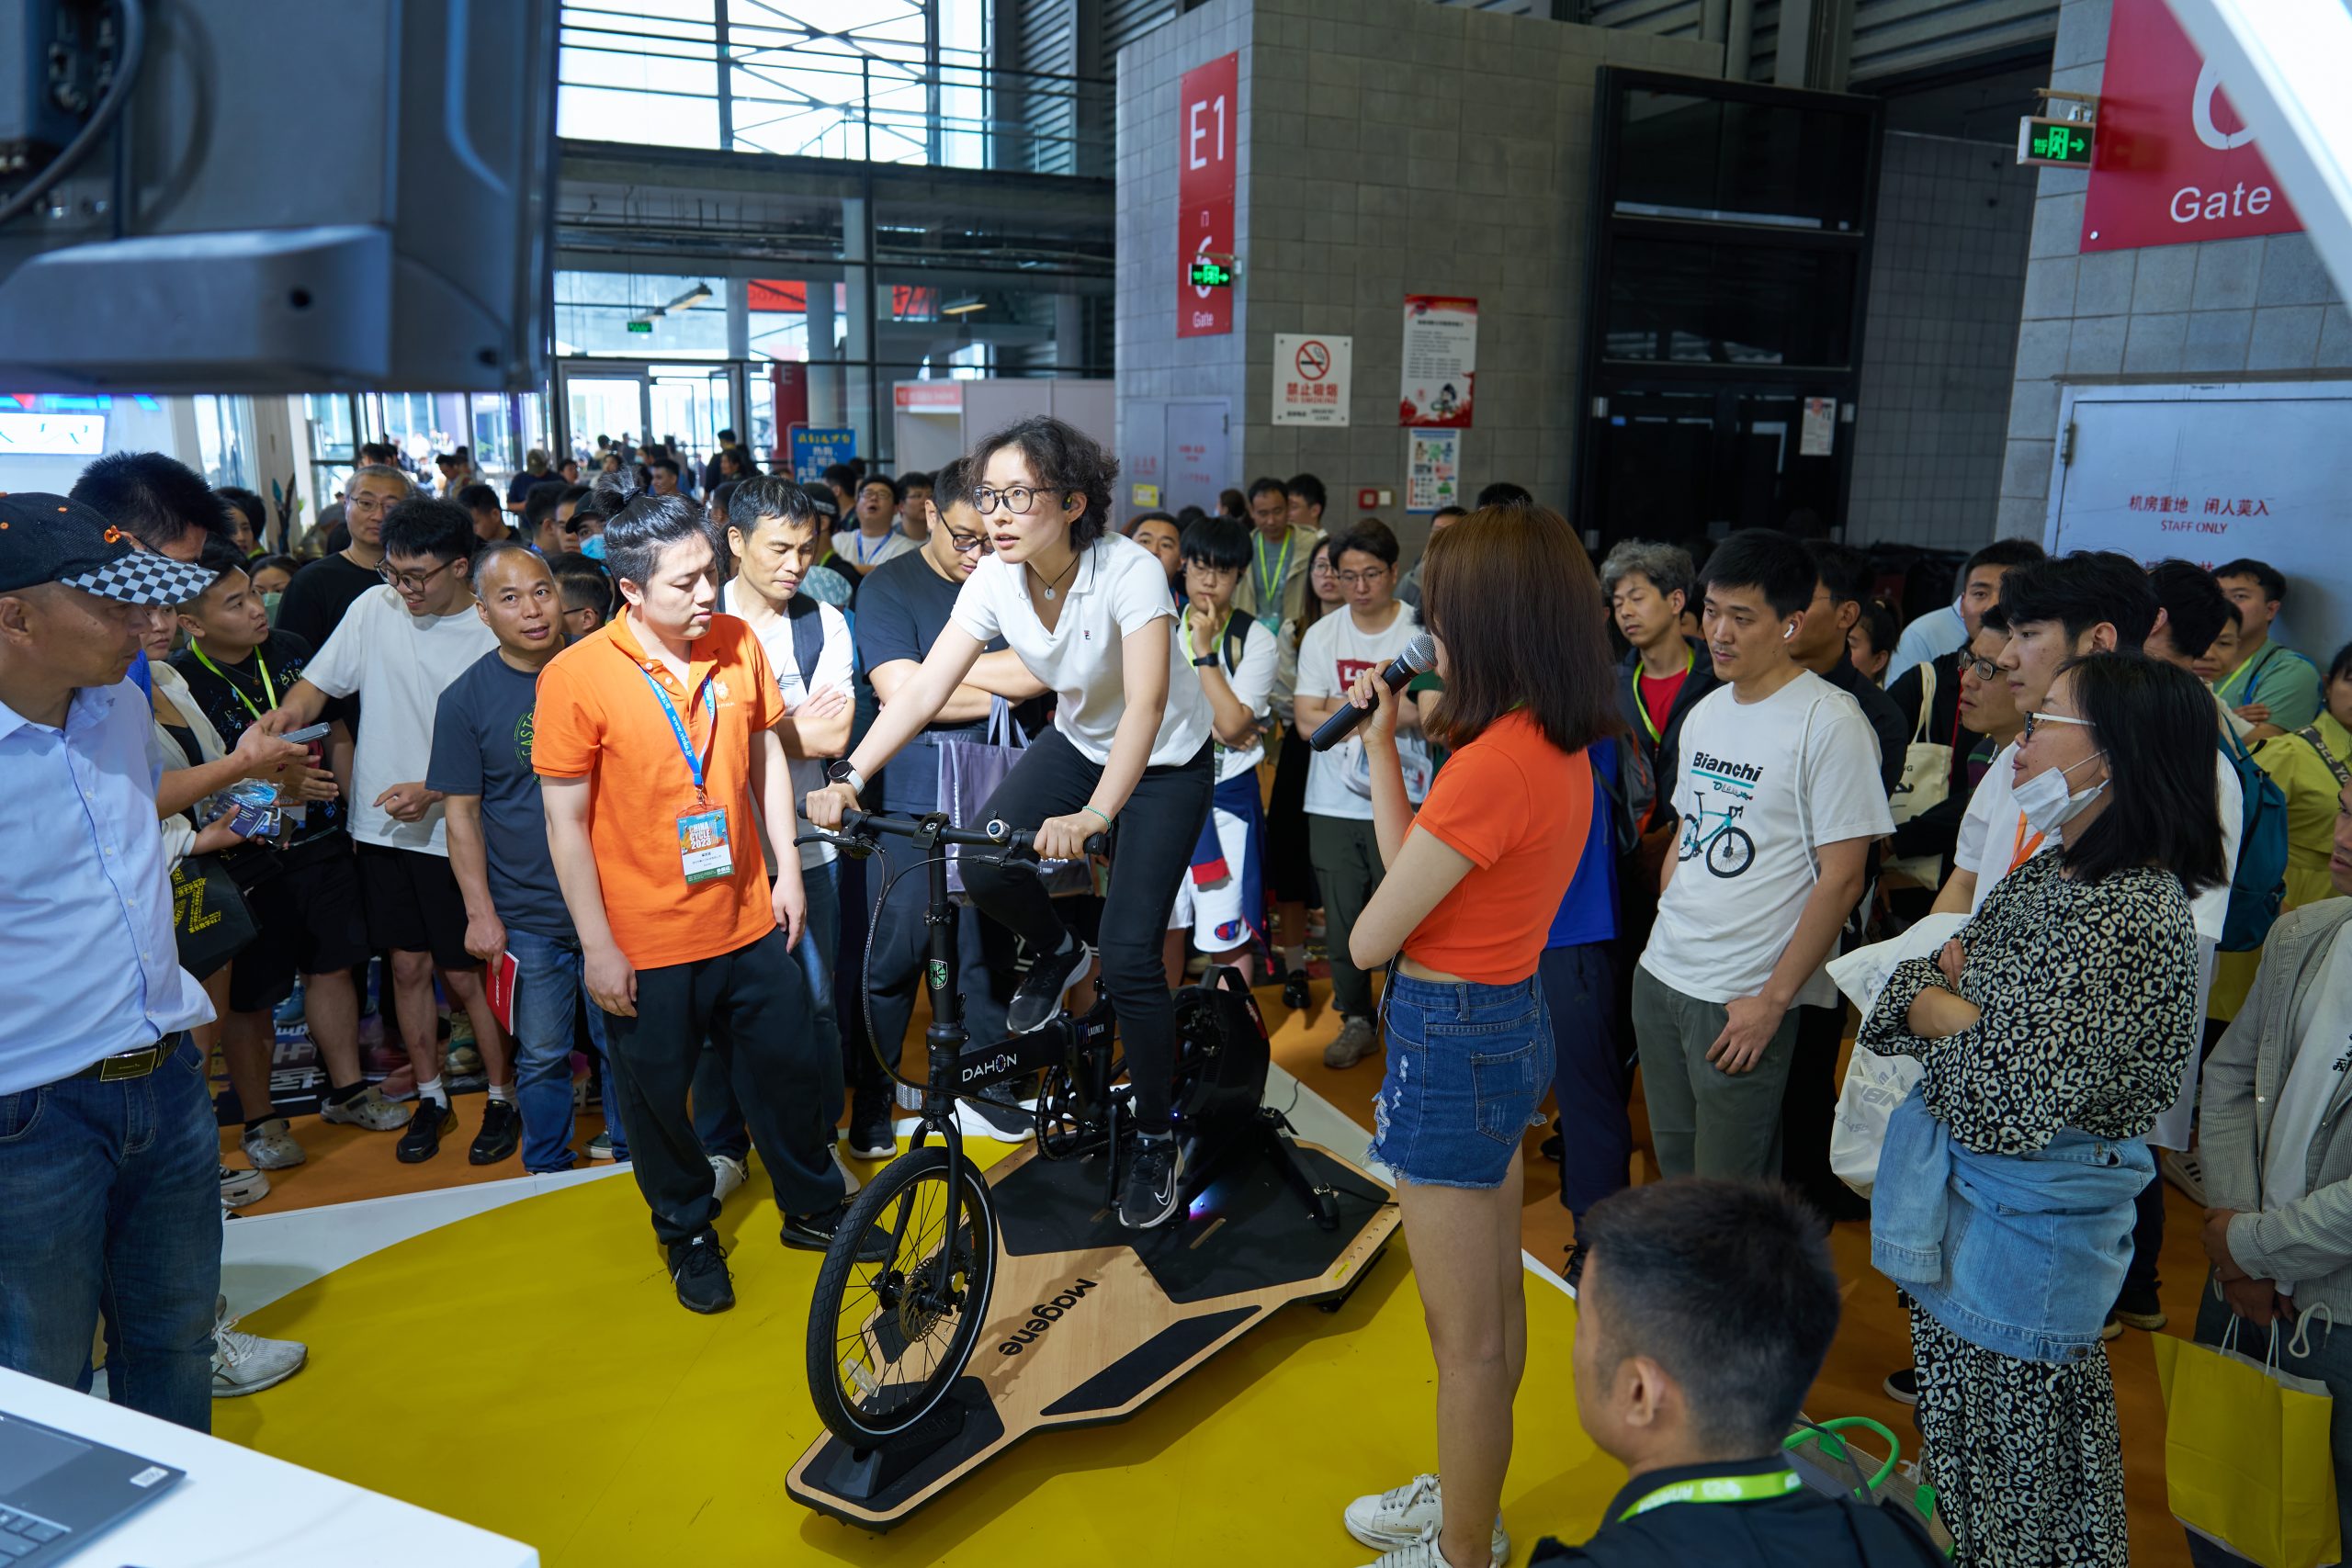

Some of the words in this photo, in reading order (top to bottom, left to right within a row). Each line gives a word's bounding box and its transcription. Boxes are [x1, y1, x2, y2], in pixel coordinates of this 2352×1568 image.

[1191, 95, 1225, 170] E1
[2170, 182, 2272, 223] Gate
[1193, 310, 1214, 328] Gate
[1286, 382, 1338, 397] 禁止吸烟
[2130, 495, 2188, 513] 机房重地
[2204, 498, 2269, 517] 闲人莫入
[2161, 520, 2193, 533] STAFF
[2196, 521, 2228, 535] ONLY
[1692, 751, 1764, 783] Bianchi
[689, 821, 709, 833] CHINA
[690, 829, 712, 842] CYCLE
[691, 837, 712, 850] 2023
[962, 1053, 1017, 1082] DAHON
[998, 1278, 1099, 1357] Magene
